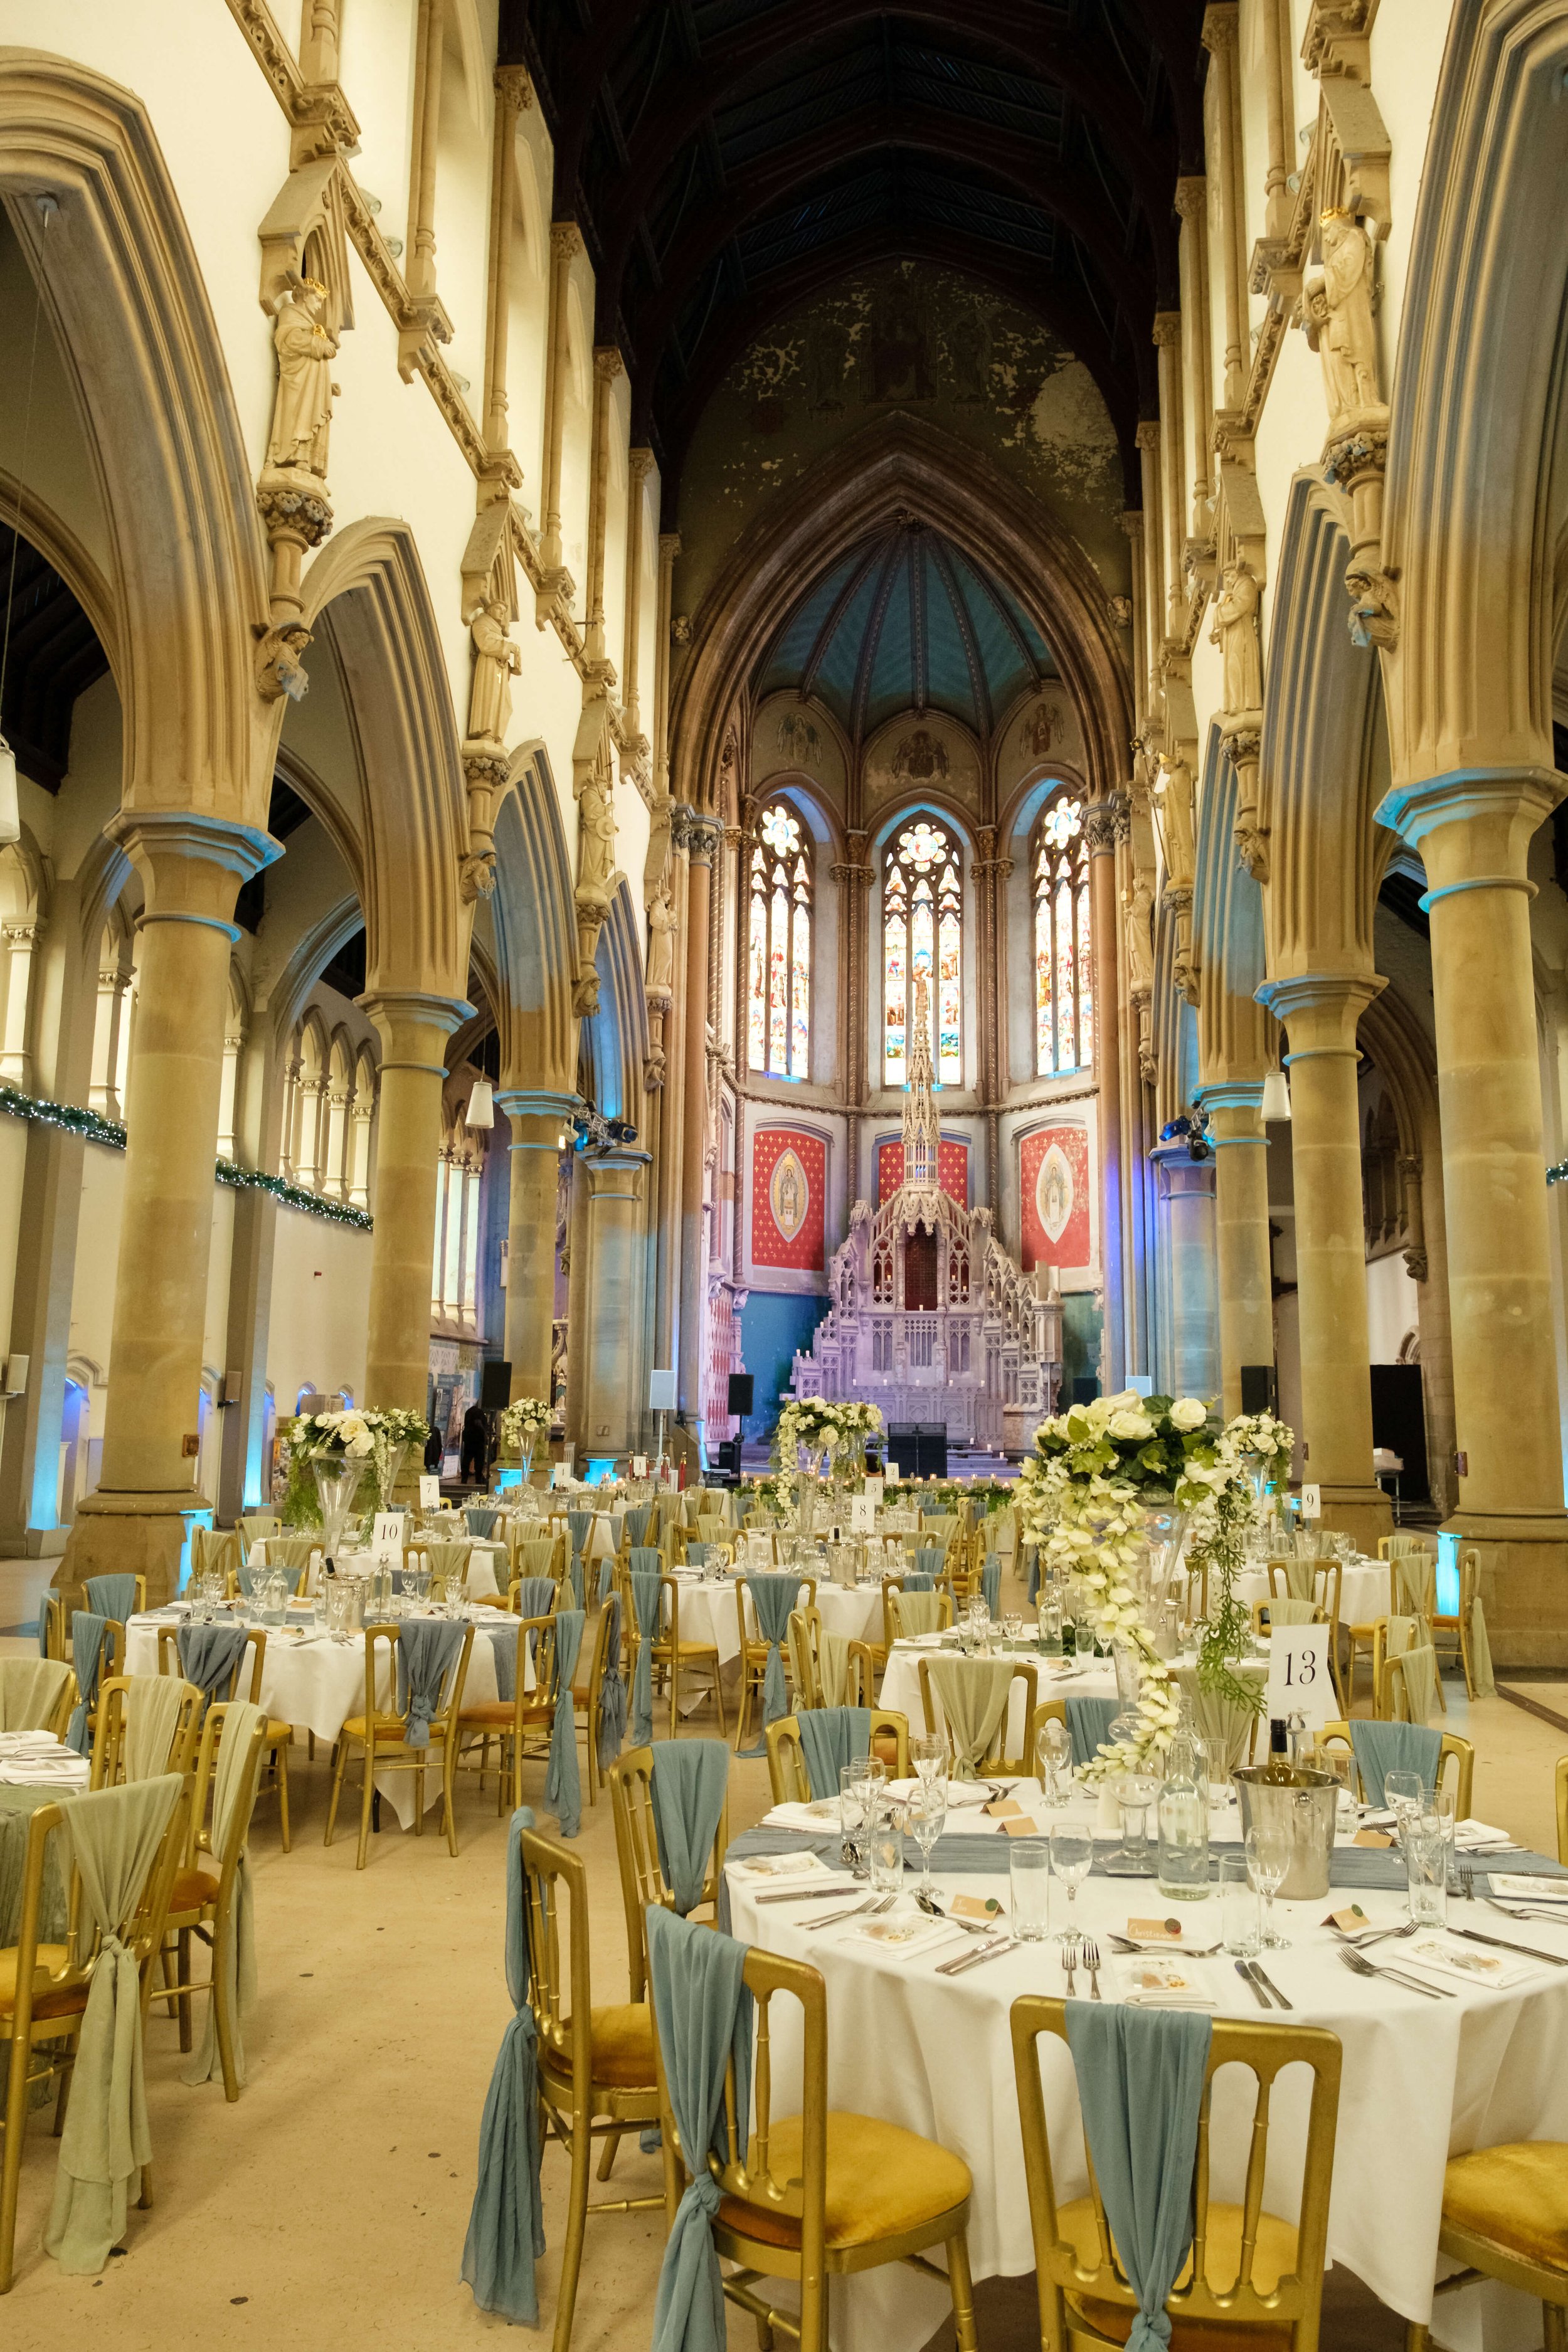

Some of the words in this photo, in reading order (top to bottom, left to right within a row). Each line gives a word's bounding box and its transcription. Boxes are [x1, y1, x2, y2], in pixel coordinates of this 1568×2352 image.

[890, 1466, 895, 1475] 2
[426, 1483, 432, 1494] 7
[871, 1483, 877, 1493] 5
[1306, 1493, 1314, 1508] 9
[859, 1503, 866, 1517] 8
[381, 1523, 398, 1540] 10
[1284, 1650, 1316, 1686] 13
